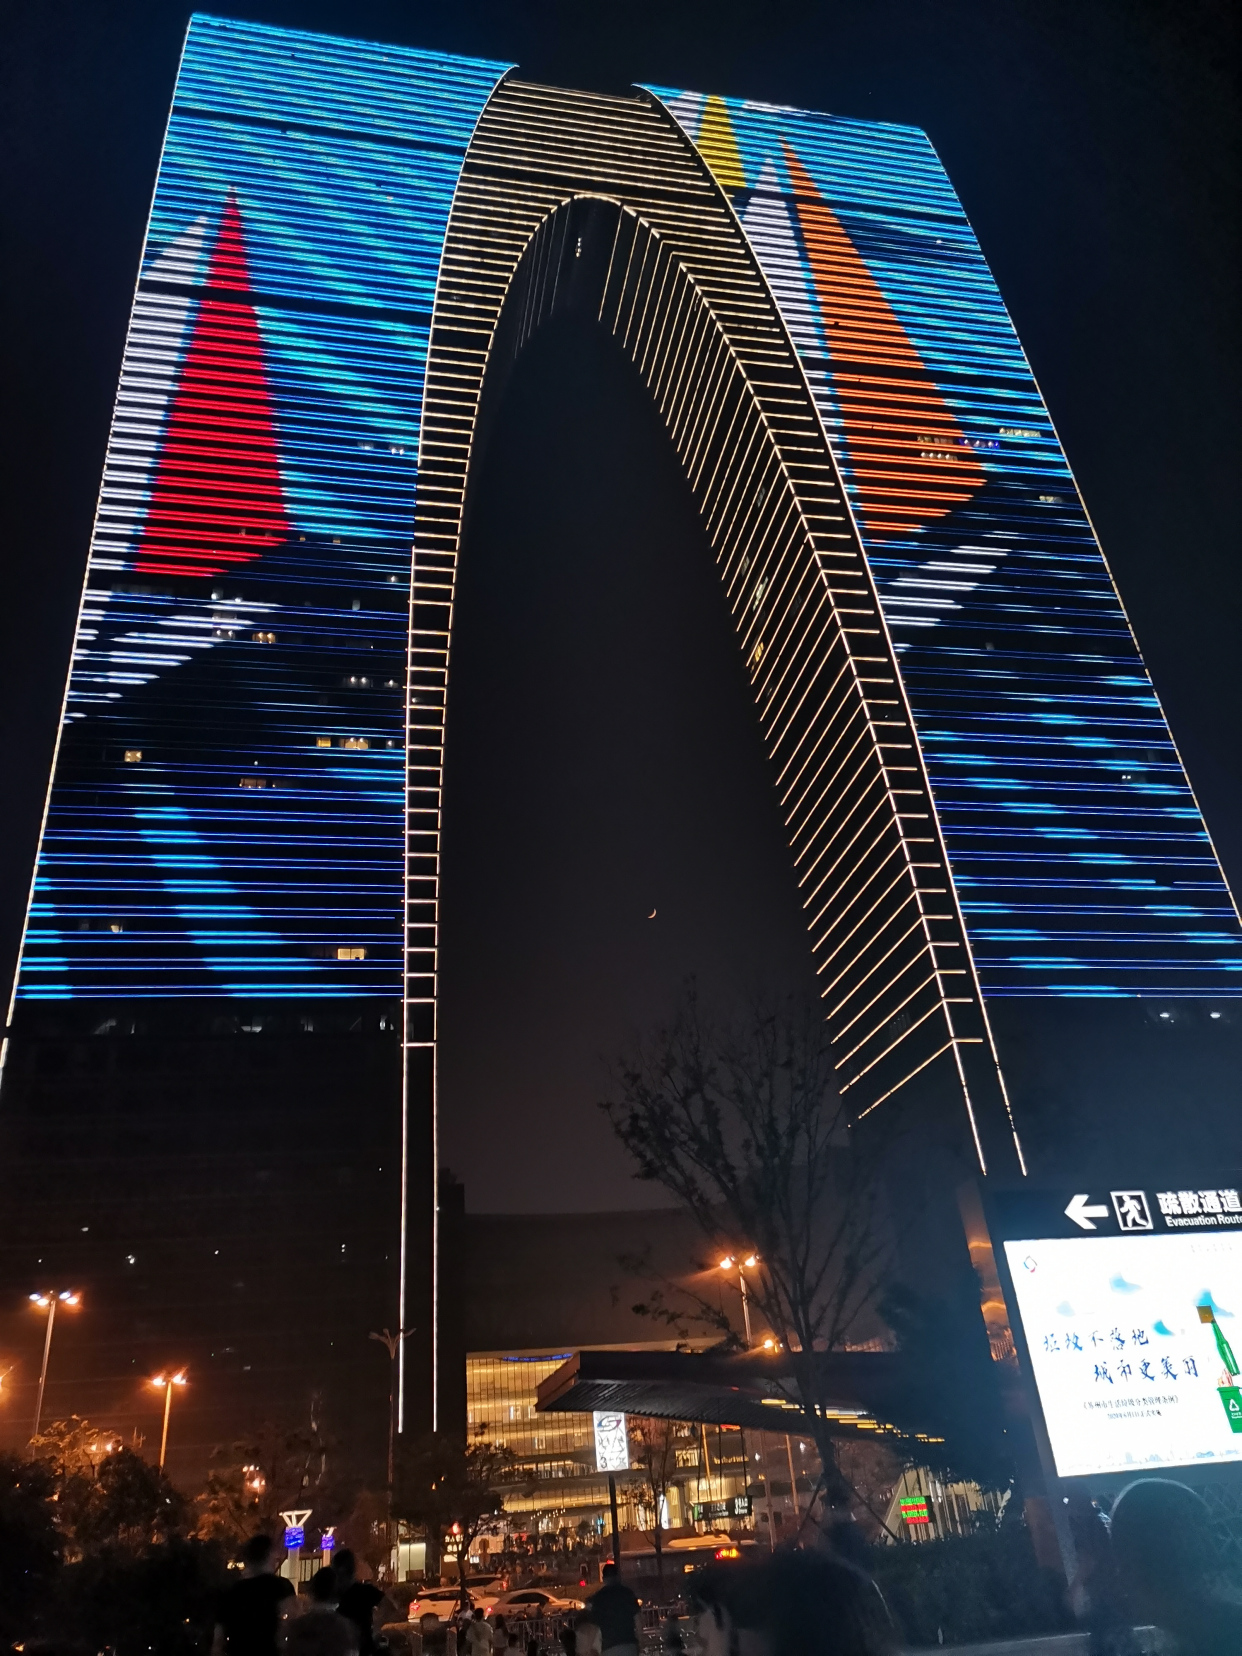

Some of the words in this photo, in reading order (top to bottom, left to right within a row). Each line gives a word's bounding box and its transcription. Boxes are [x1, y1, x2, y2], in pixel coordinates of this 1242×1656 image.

[1156, 1188, 1242, 1215] 疏散通道
[1164, 1214, 1218, 1227] Evacuation
[1043, 1327, 1149, 1352] 垃圾不落地
